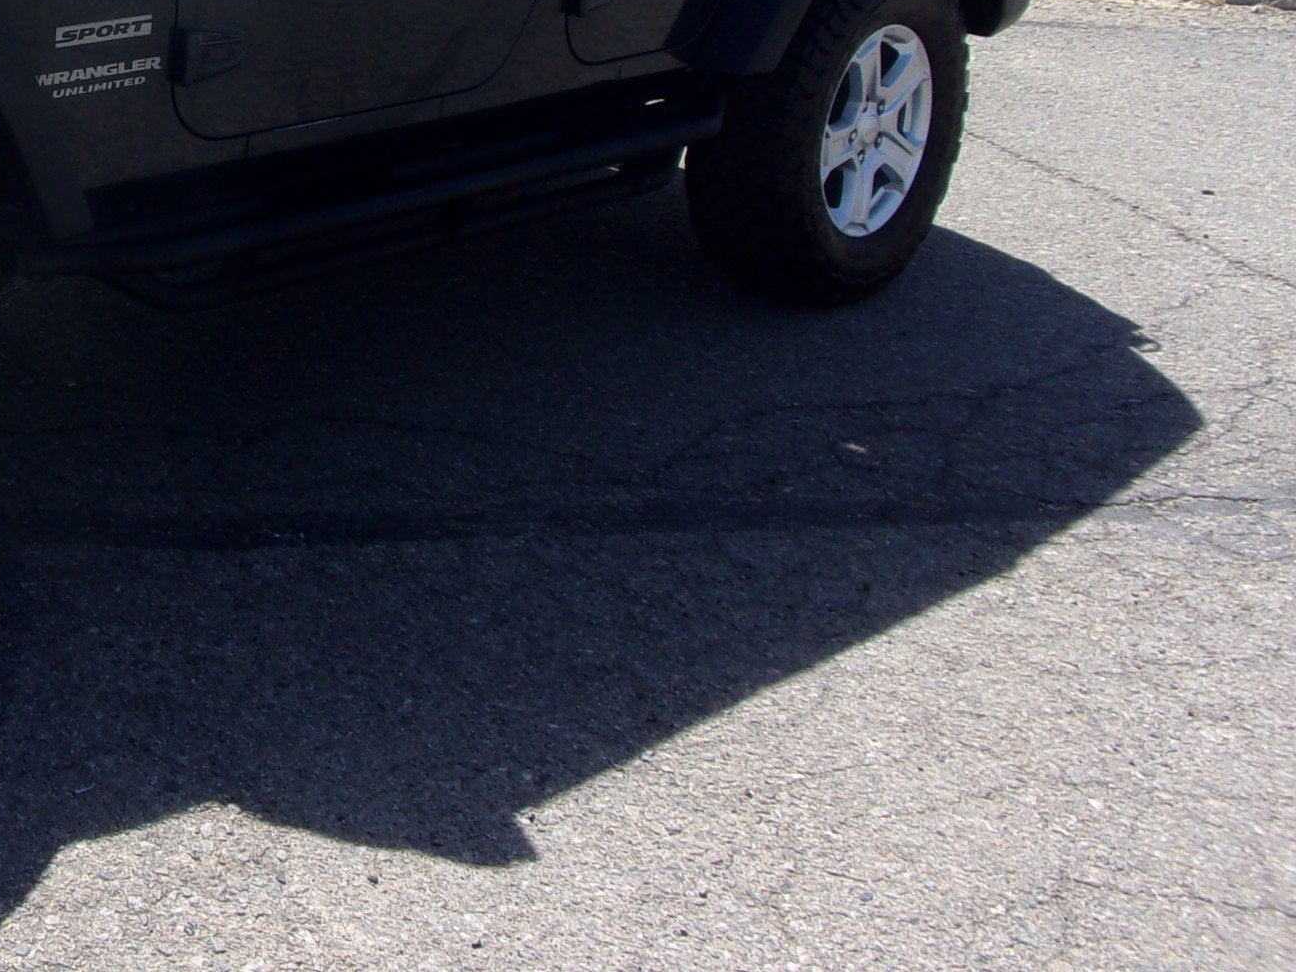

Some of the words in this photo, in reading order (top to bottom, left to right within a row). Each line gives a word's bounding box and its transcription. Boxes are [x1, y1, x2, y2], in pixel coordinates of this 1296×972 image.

[58, 19, 151, 43] SPORT
[35, 56, 162, 87] WRANGLER
[52, 76, 146, 99] UNLIMITED
